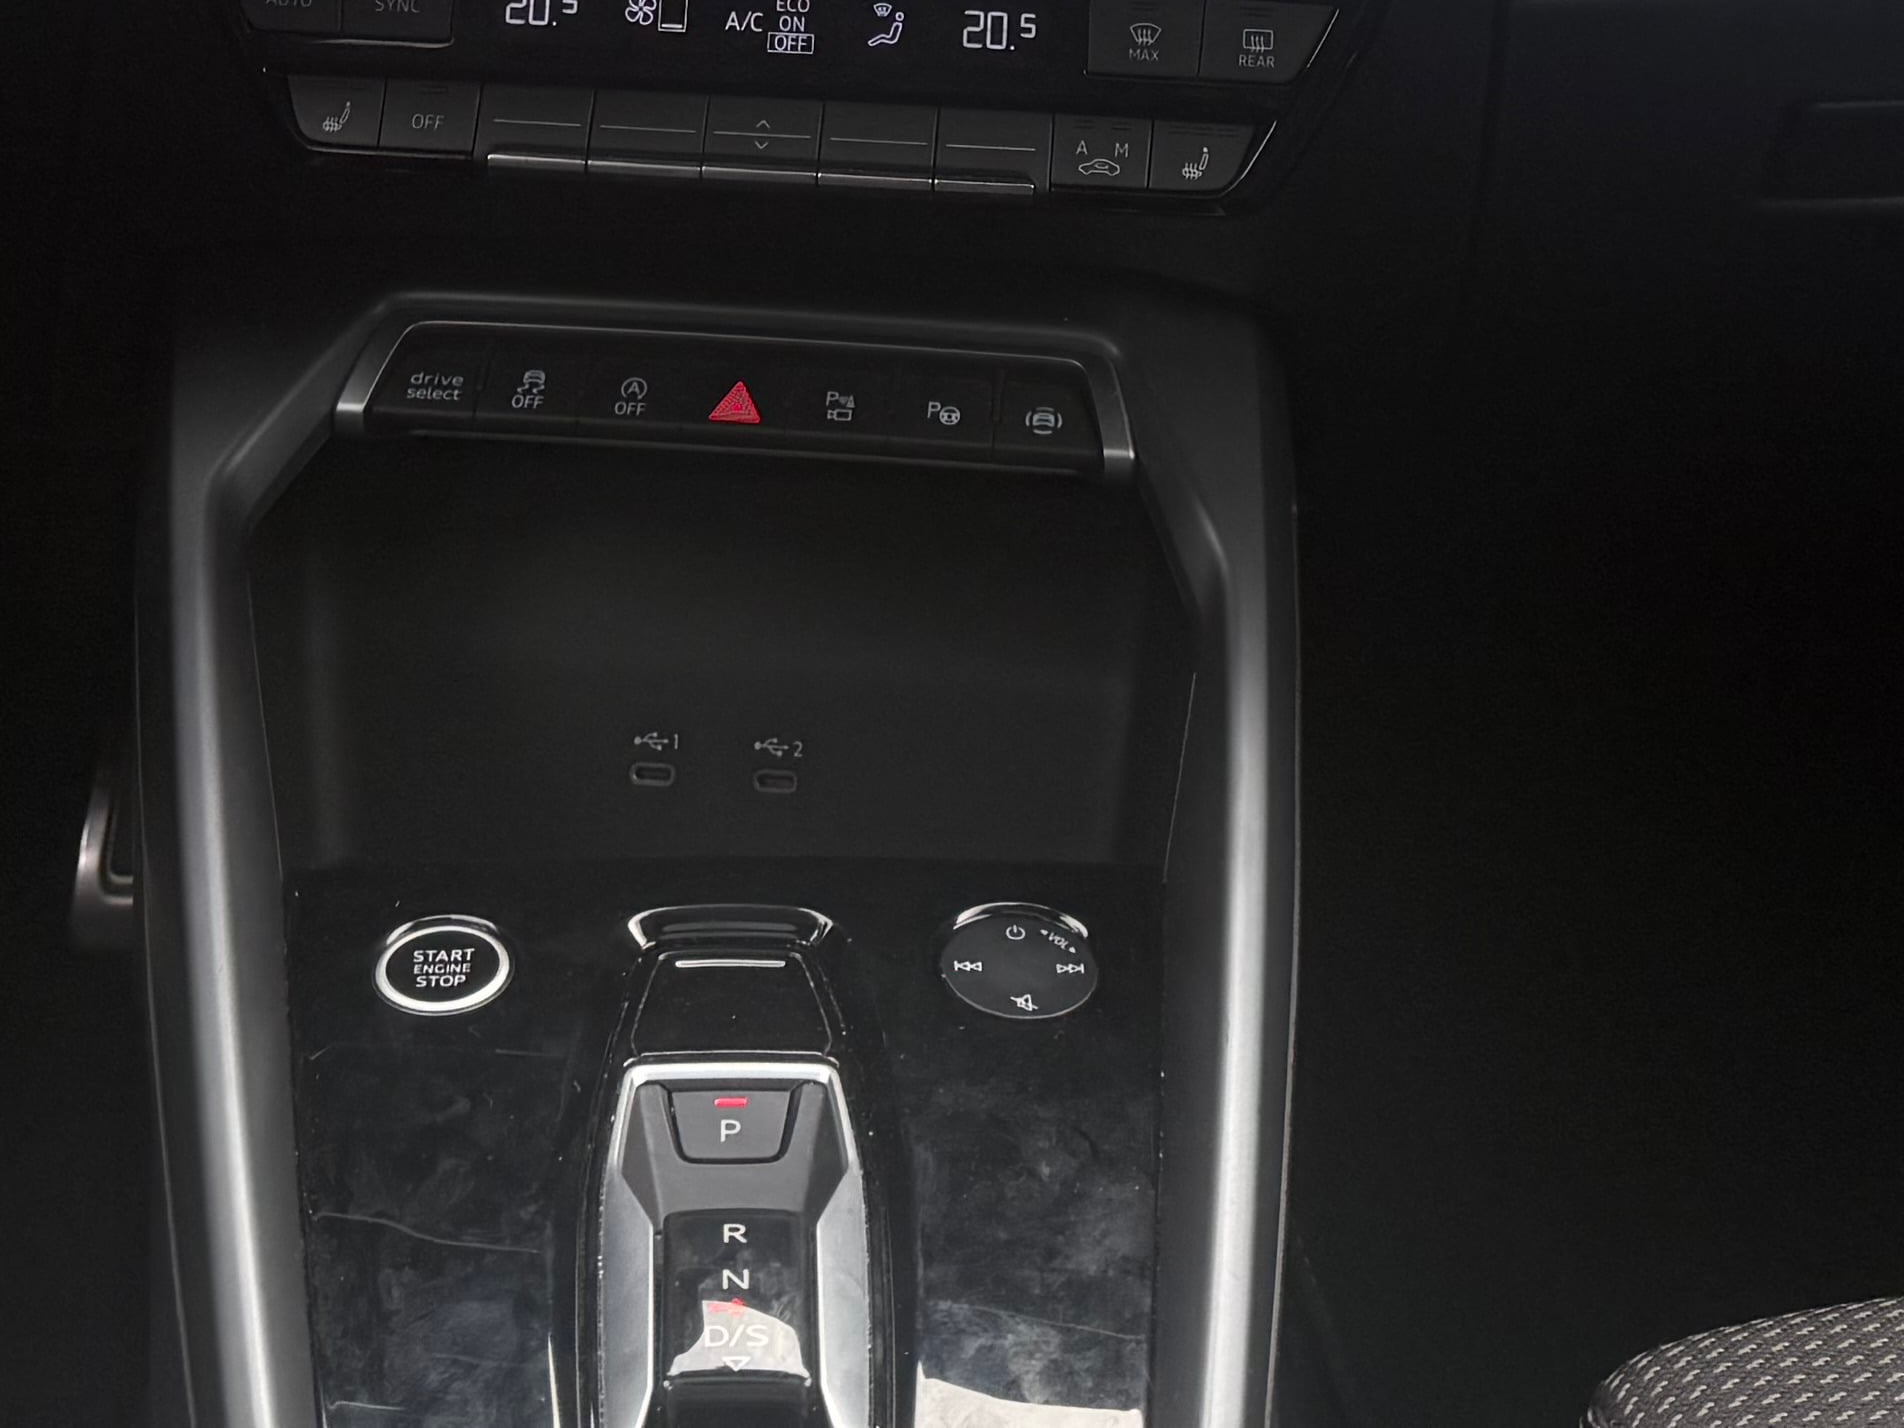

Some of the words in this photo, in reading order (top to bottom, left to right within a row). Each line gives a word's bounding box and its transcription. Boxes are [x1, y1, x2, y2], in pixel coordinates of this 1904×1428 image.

[725, 10, 763, 32] A/C
[779, 15, 805, 32] ON
[774, 35, 807, 51] OFF
[1128, 47, 1160, 63] MAX
[1238, 54, 1275, 70] REAR
[411, 113, 446, 131] OFF
[1075, 140, 1088, 156] A
[1114, 142, 1129, 159] M
[410, 371, 464, 387] drive
[406, 385, 461, 401] select
[511, 394, 545, 410] OFF
[614, 401, 647, 416] OFF
[793, 740, 803, 757] 2
[1048, 932, 1069, 950] VOL
[413, 948, 475, 963] START
[413, 963, 472, 975] ENGINE
[415, 974, 466, 988] STOP
[720, 1119, 742, 1143] P
[722, 1223, 748, 1244] R
[722, 1269, 750, 1290] N
[703, 1324, 770, 1349] D/S
